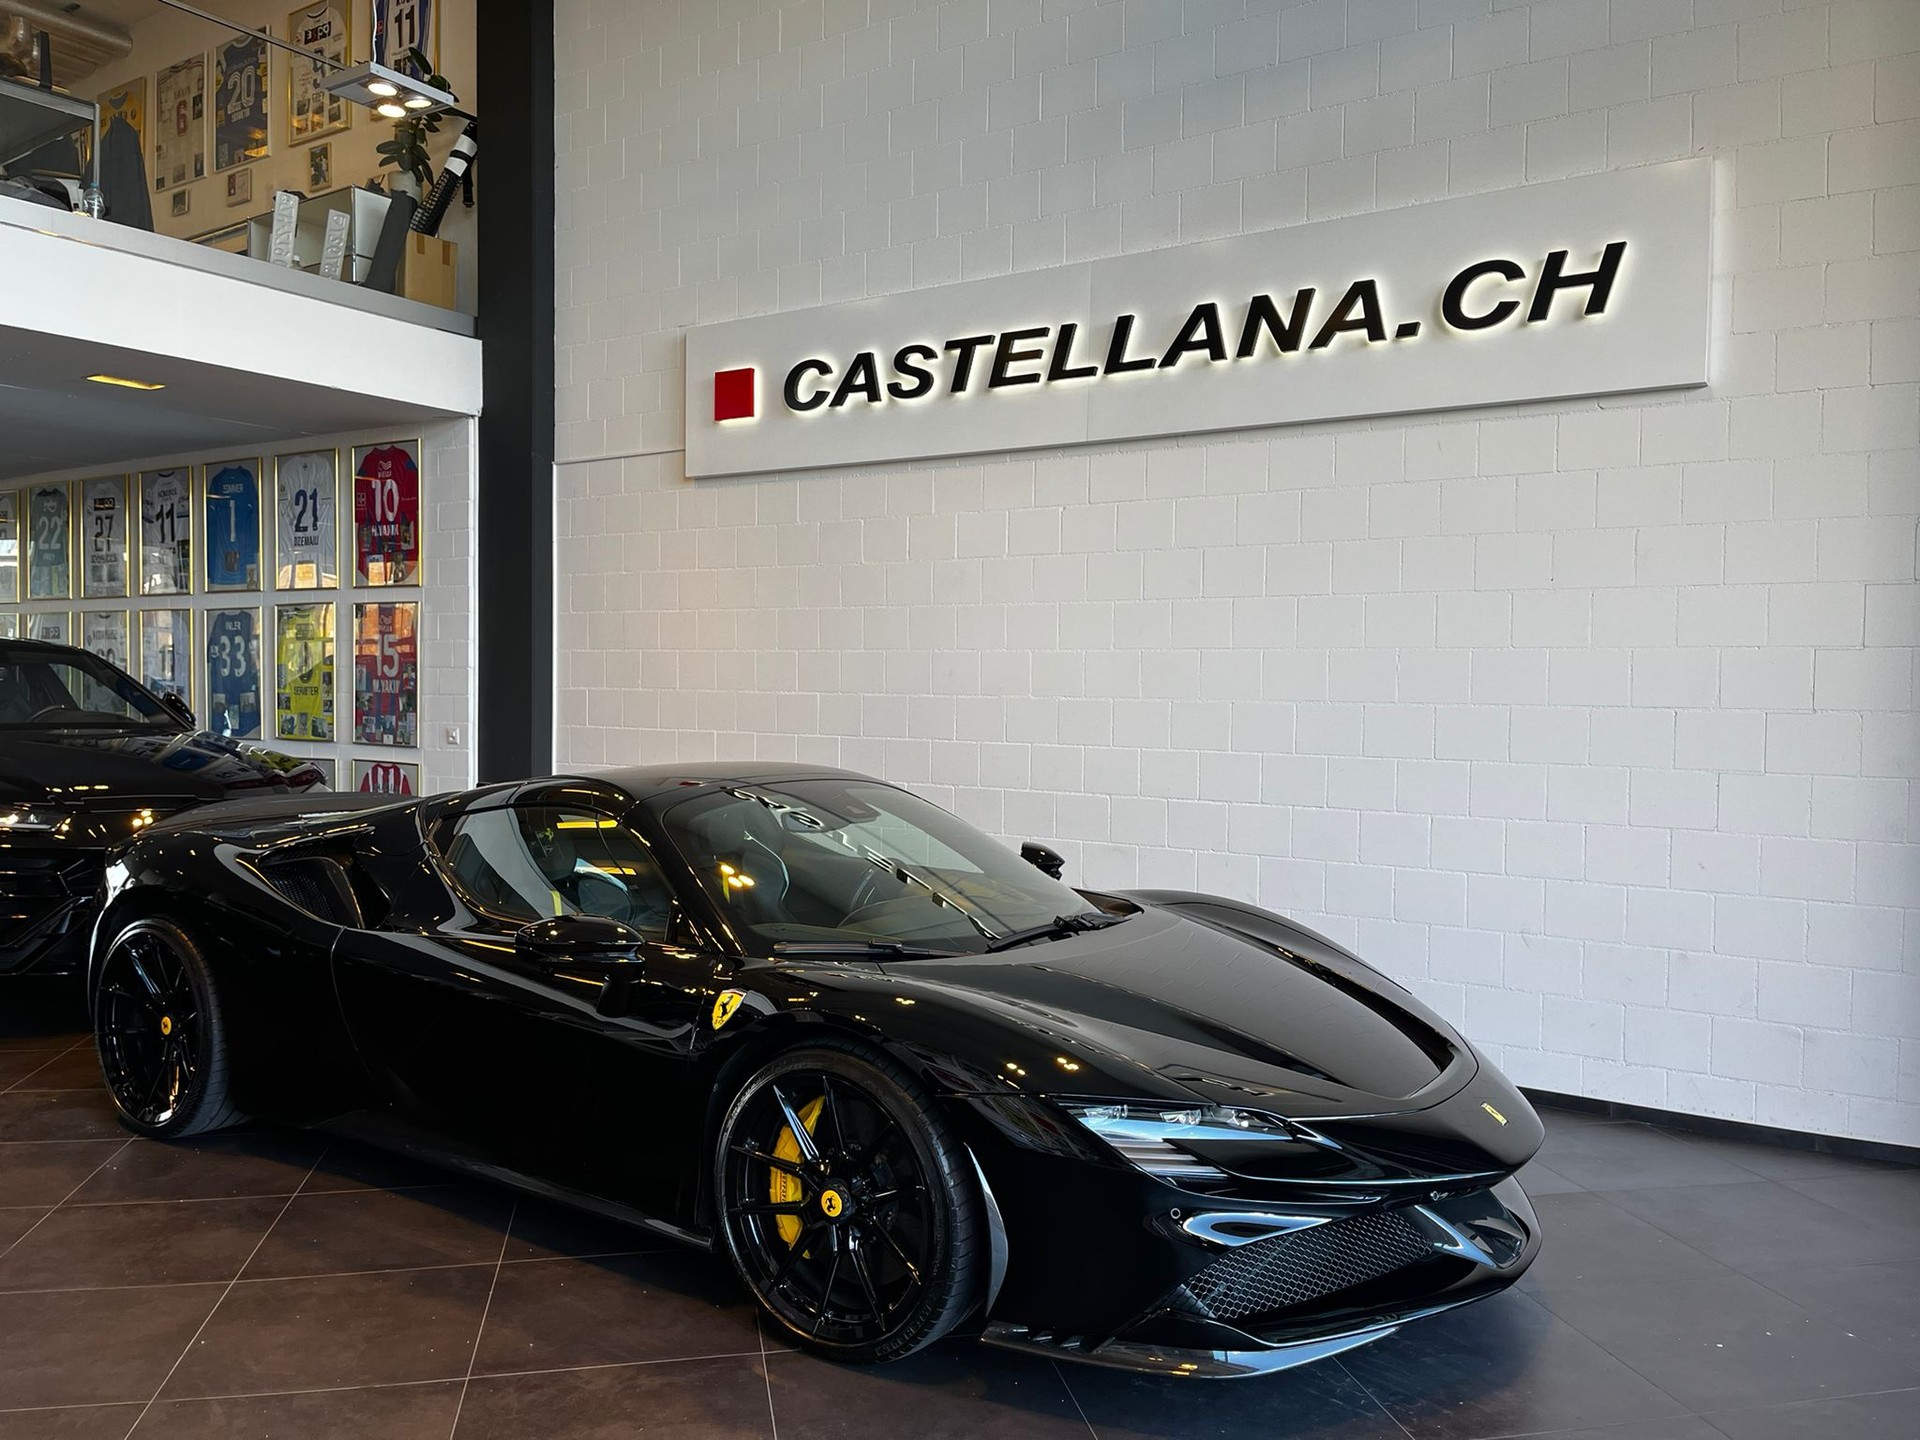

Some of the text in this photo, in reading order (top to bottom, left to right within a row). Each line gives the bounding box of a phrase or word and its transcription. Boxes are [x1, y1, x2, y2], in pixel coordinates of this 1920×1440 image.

[394, 5, 415, 48] 11
[227, 65, 255, 115] 20
[176, 99, 187, 137] 6
[784, 241, 1628, 412] CASTELLANA.CH
[229, 499, 236, 542] 1
[294, 488, 318, 533] 21
[371, 479, 400, 522] 10
[38, 516, 61, 550] 22
[95, 515, 114, 552] 27
[155, 503, 175, 544] 11
[220, 635, 246, 678] 33
